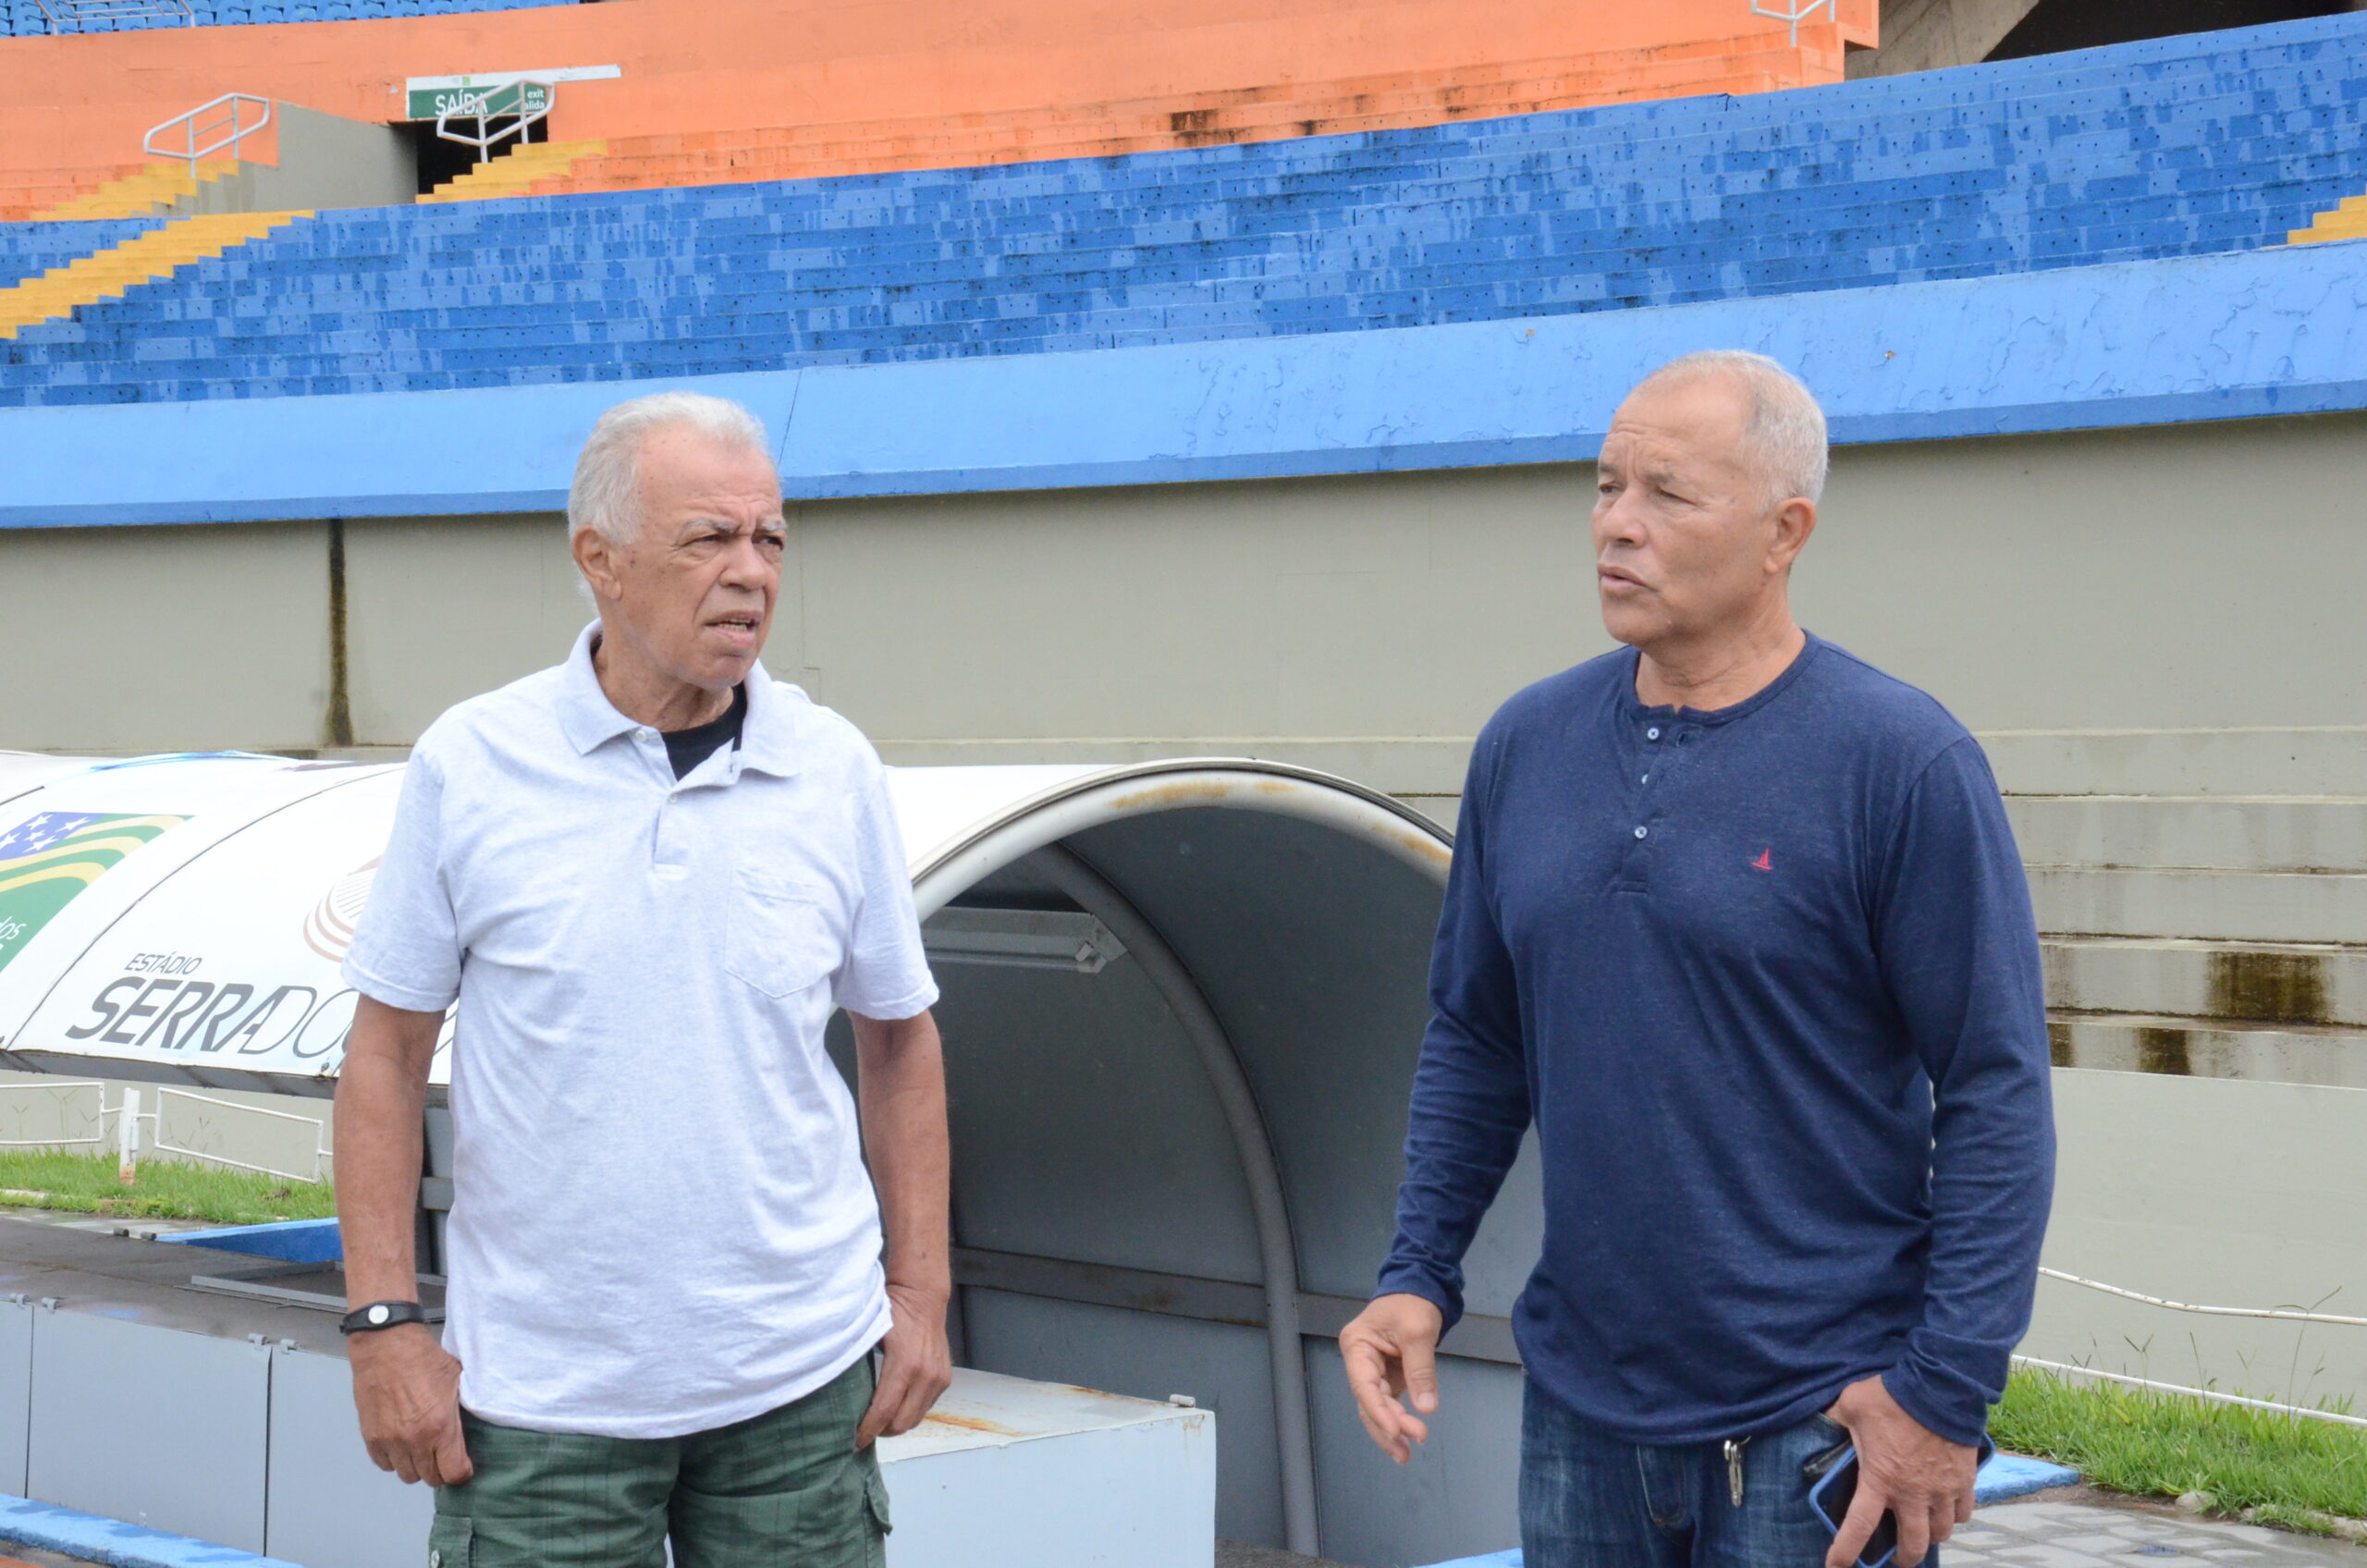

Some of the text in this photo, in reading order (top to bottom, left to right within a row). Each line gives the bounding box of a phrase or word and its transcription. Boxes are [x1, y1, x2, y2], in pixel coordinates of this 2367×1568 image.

[527, 90, 545, 99] exit
[525, 100, 545, 110] alida
[124, 951, 202, 975] ESTÁDIO
